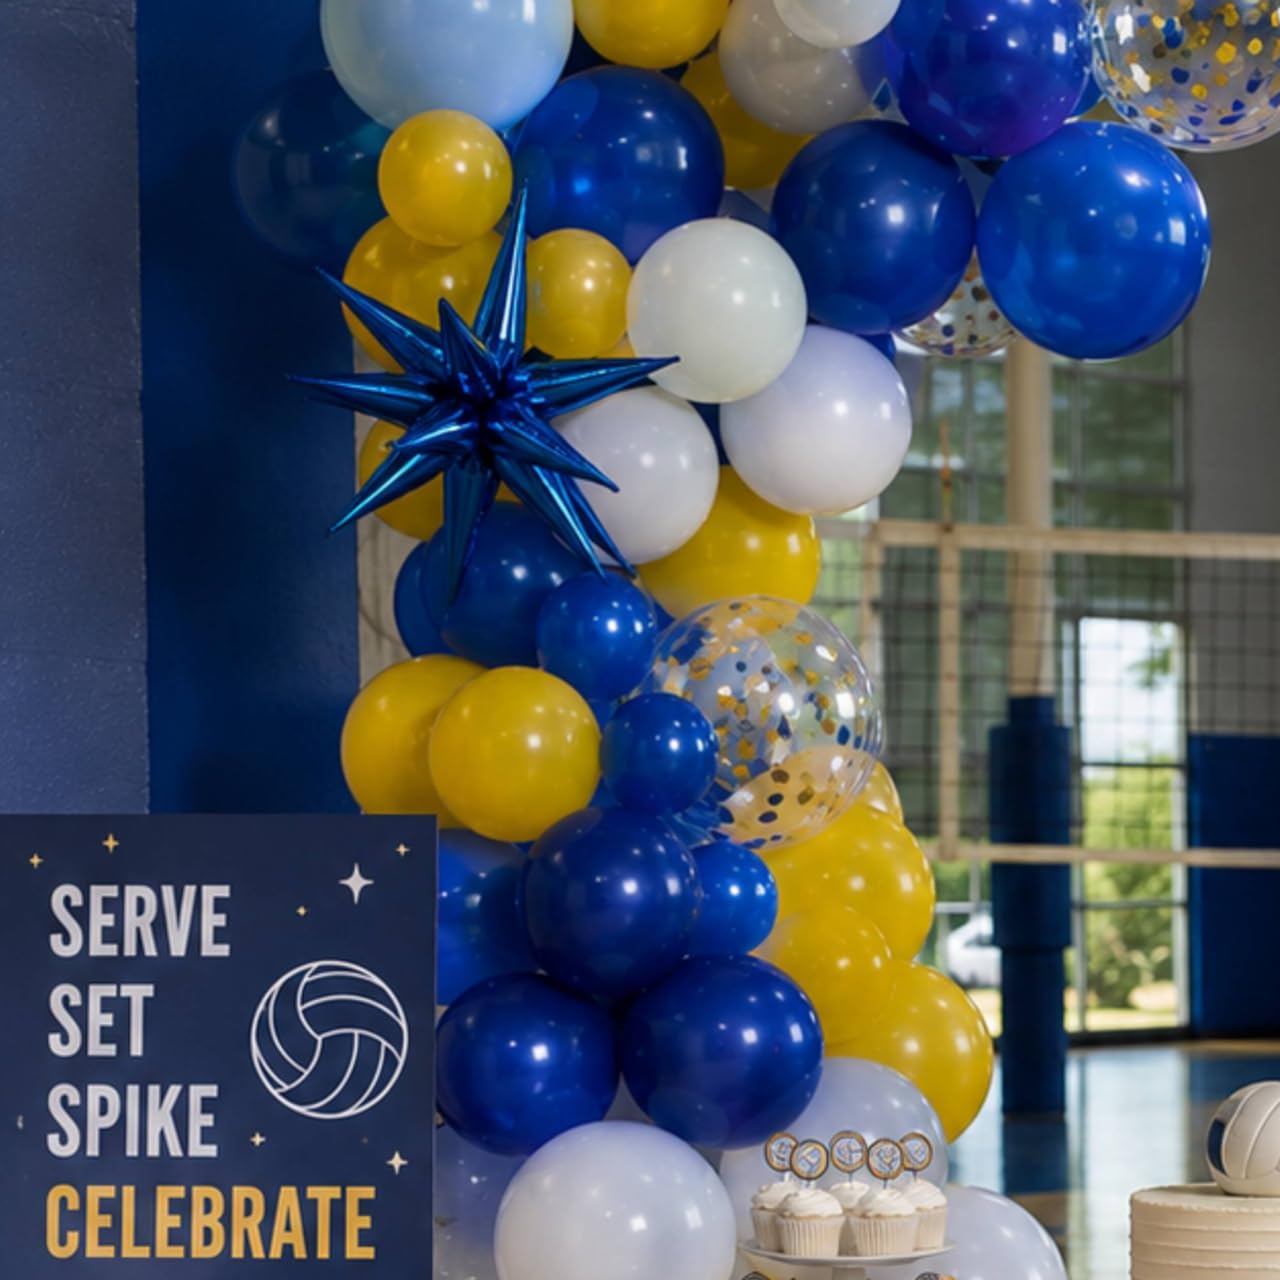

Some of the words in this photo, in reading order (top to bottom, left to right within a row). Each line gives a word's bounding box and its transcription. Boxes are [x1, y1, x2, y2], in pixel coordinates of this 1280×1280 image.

[49, 884, 230, 957] SERVE
[48, 983, 154, 1057] SET
[47, 1083, 219, 1158] SPIKE
[46, 1184, 376, 1260] CELEBRATE
